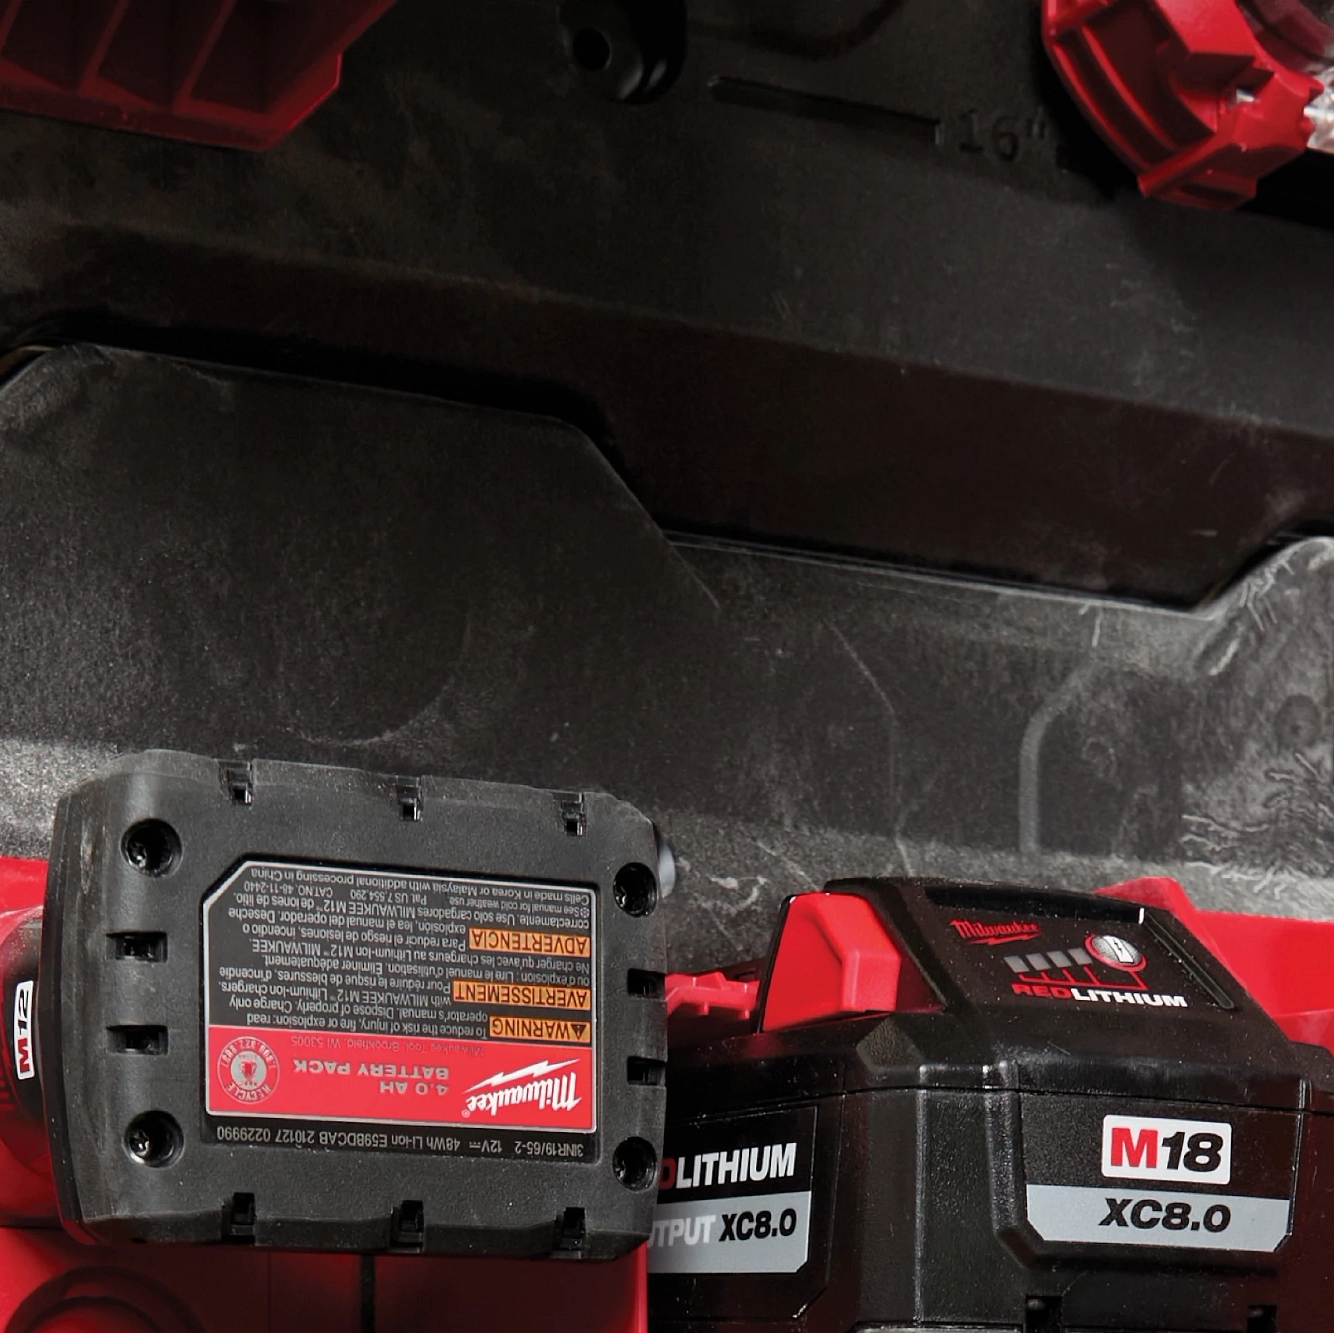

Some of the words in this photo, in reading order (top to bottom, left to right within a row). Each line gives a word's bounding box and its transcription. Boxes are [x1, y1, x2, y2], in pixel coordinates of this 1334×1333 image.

[950, 919, 1040, 938] Milwaukee
[471, 931, 587, 954] ADVERTENCIA
[456, 983, 587, 1007] AVERTISSEMENT
[1011, 982, 1188, 1008] REDLITHIUM
[18, 989, 29, 1073] M12
[492, 1018, 570, 1040] WARNING
[293, 1060, 350, 1075] PACK
[357, 1063, 449, 1079] BATTERY
[380, 1081, 407, 1093] AH
[416, 1083, 449, 1095] 4.0
[465, 1072, 582, 1116] Milwaukee
[217, 1126, 270, 1140] 0229990
[275, 1129, 314, 1143] 210127
[319, 1131, 387, 1147] E59BDCAB
[427, 1137, 460, 1151] 48Wh
[515, 1142, 584, 1156] 3INR19/65-2
[1111, 1128, 1224, 1172] M18
[1098, 1197, 1231, 1233] XC8.0
[719, 1208, 797, 1242] XC8.0
